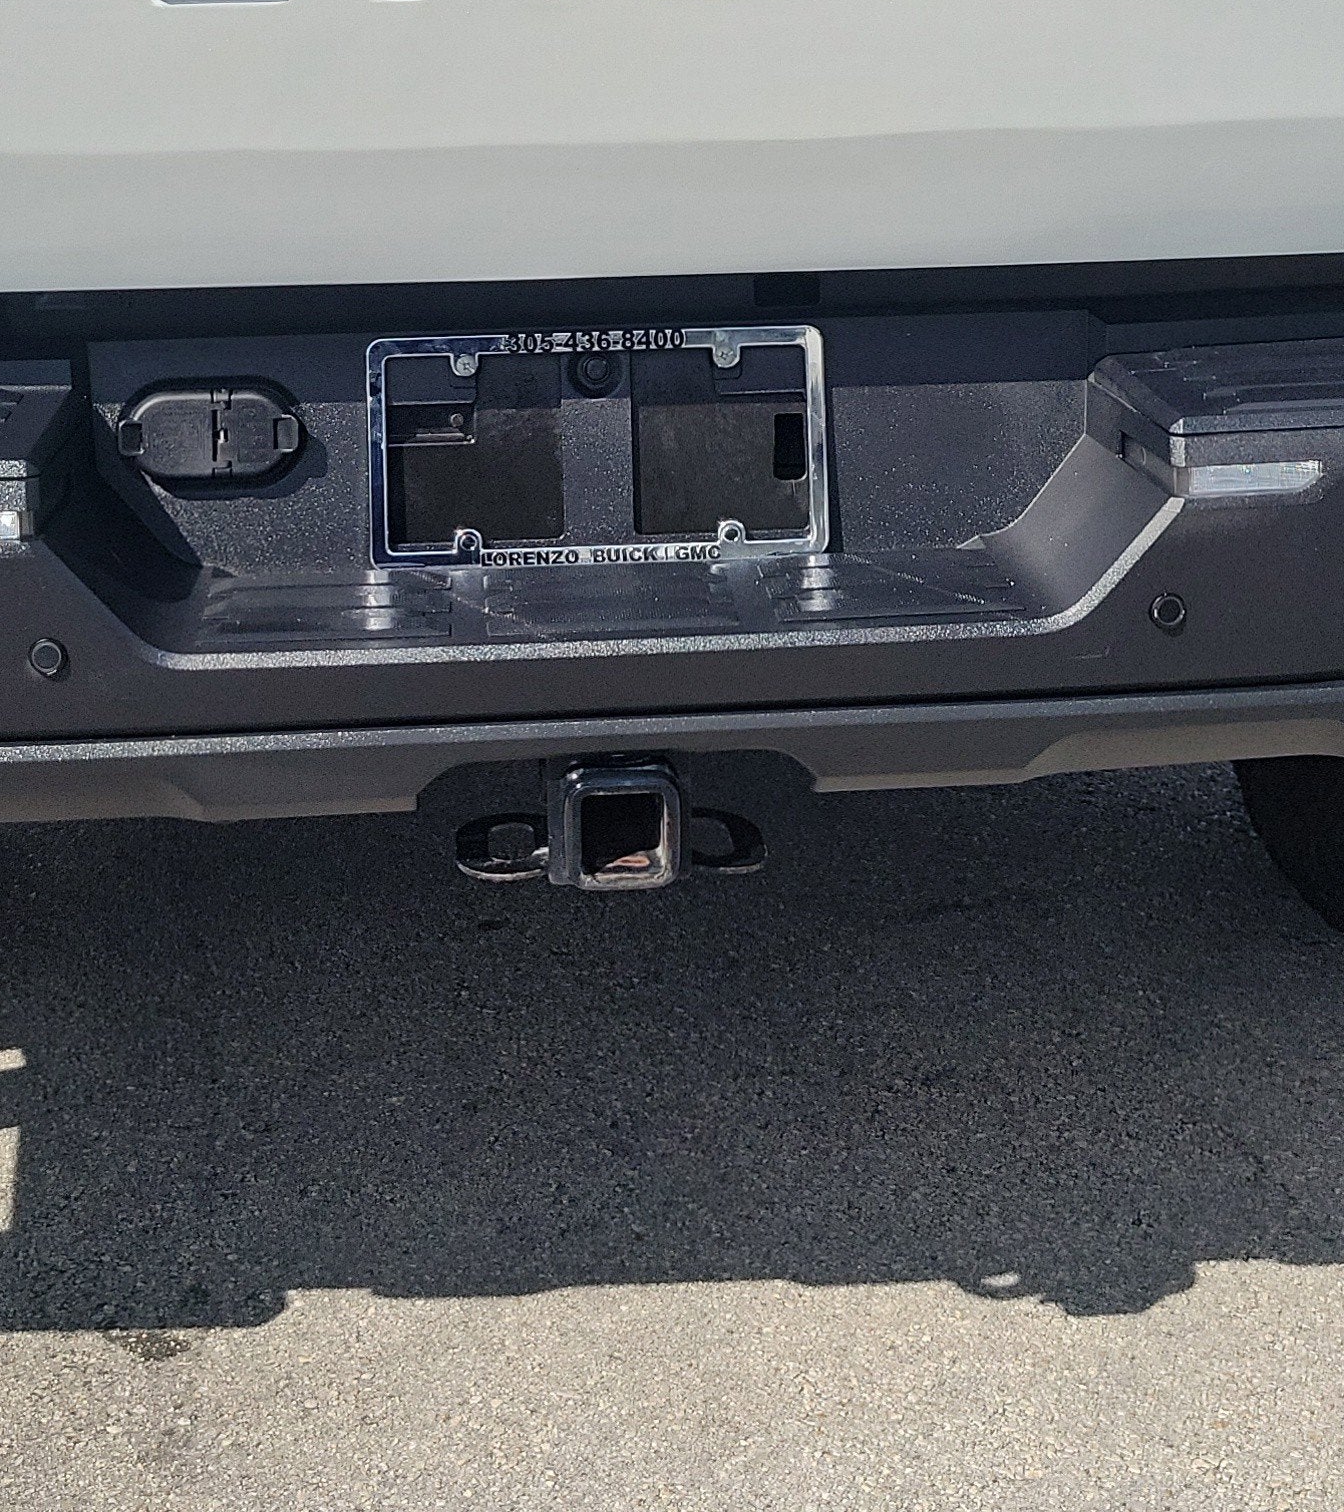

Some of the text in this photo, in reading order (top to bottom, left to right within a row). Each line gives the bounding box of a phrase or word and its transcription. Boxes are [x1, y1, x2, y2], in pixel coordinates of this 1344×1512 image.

[507, 330, 685, 353] 305-436-8400
[481, 549, 580, 567] LORENZO
[593, 546, 657, 563] BUICK
[675, 544, 722, 560] GMC
